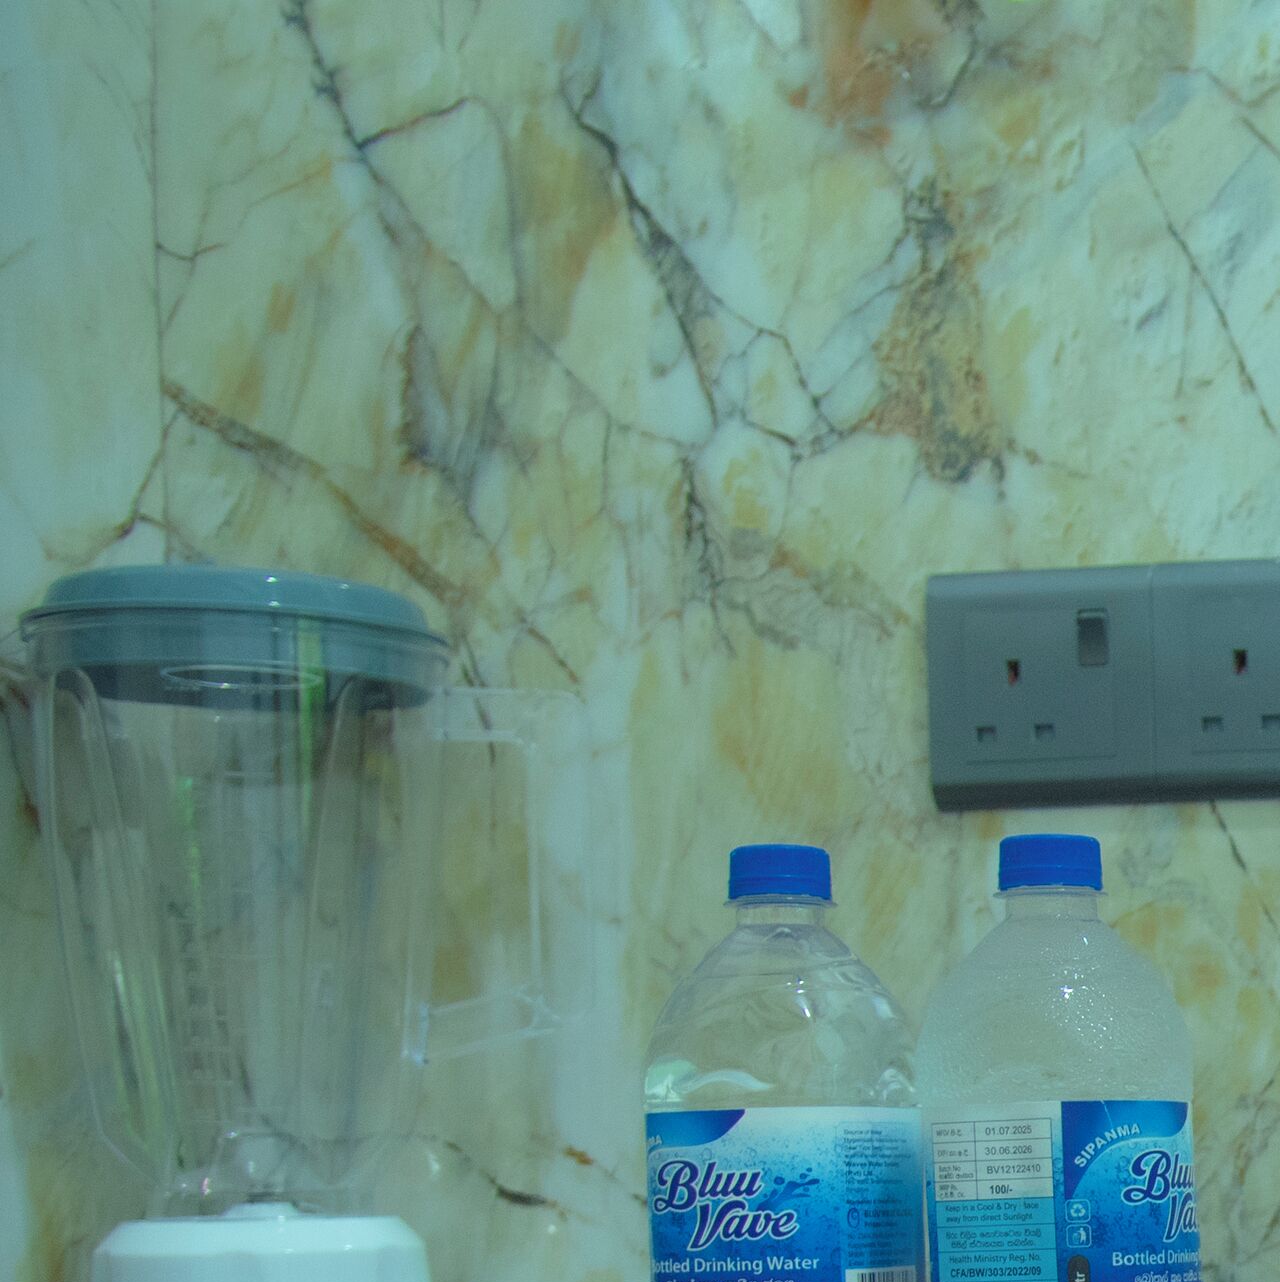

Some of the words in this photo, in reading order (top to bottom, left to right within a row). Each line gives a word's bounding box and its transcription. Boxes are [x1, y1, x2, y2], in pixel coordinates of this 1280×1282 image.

[985, 1125, 1032, 1136] 01.07.2025
[984, 1144, 1033, 1156] 30.06.2026
[1074, 1123, 1141, 1168] SIPANMA
[986, 1164, 1041, 1175] BV12122410
[654, 1159, 766, 1214] Bluu
[989, 1184, 1013, 1195] 100/-
[962, 1203, 969, 1211] in
[977, 1203, 994, 1211] Cool
[1004, 1202, 1017, 1212] Dry
[962, 1213, 979, 1222] from
[980, 1213, 1001, 1222] direct
[1003, 1212, 1033, 1223] Sunlight
[686, 1201, 801, 1251] Vave
[949, 1254, 972, 1264] Health
[973, 1254, 1008, 1264] Ministry
[1112, 1250, 1165, 1267] Bottled
[694, 1257, 763, 1275] Drinking
[767, 1256, 820, 1270] Water
[950, 1266, 1042, 1279] CFA/BW/303/2022/09
